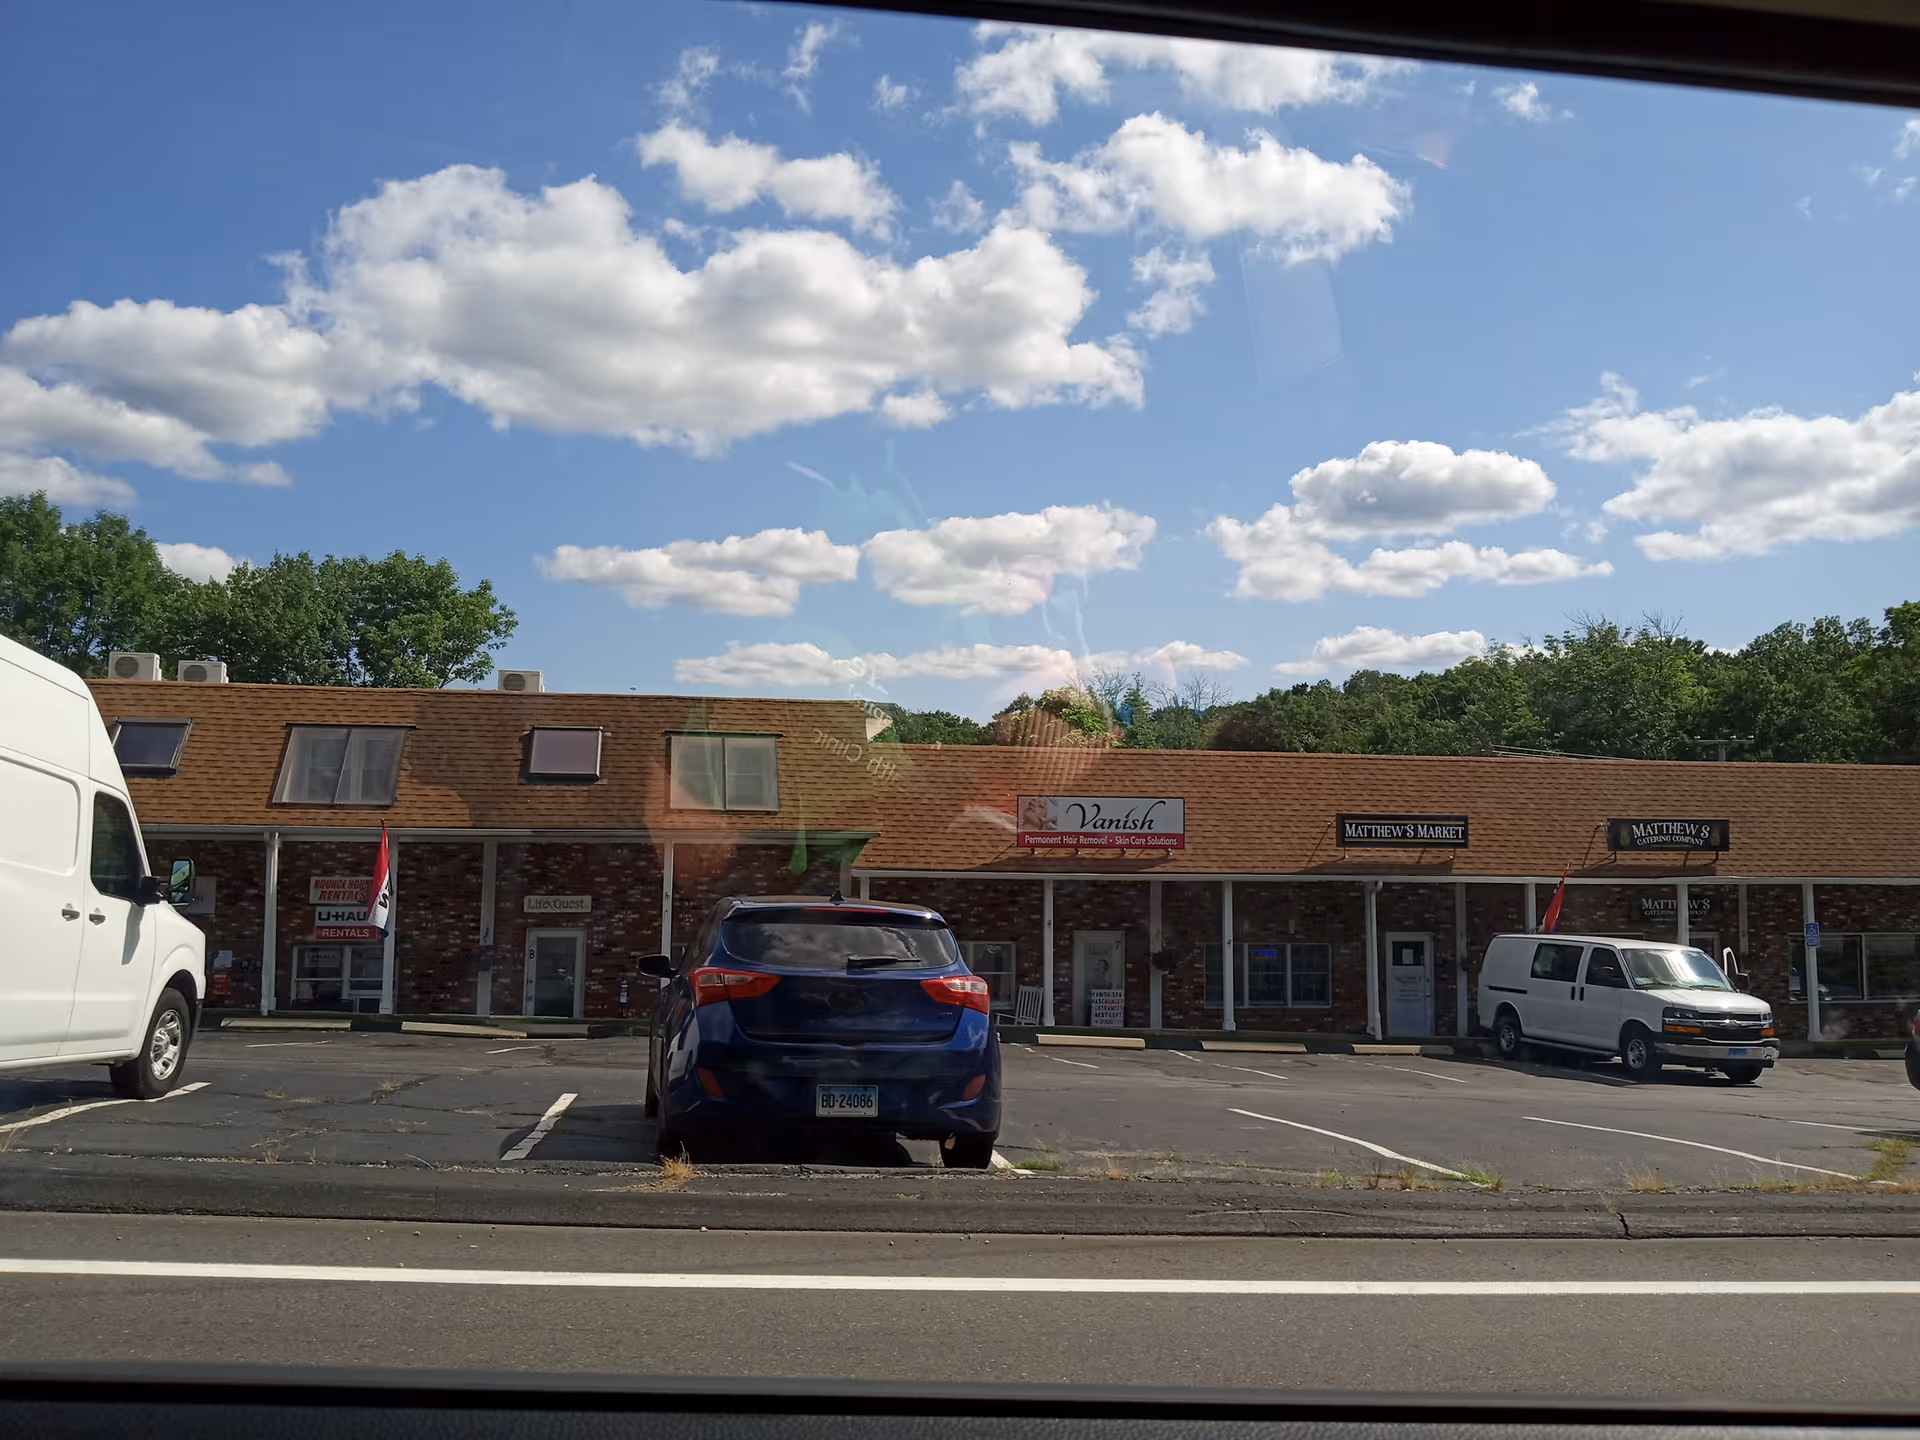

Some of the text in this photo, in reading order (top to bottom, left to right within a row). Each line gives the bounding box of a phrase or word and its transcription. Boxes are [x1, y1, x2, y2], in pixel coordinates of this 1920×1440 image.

[1065, 800, 1166, 830] Vanish
[1345, 823, 1465, 839] MATTHEW'S MARKET
[1025, 835, 1177, 846] Permanent Hair Removal Skin Care Solutions
[1636, 835, 1704, 846] CATERING COMPANY
[314, 879, 370, 889] BOUNCE HOUS
[318, 890, 368, 901] RENTALS
[553, 899, 585, 911] Quest
[1642, 898, 1710, 910] MATTW'S
[317, 911, 368, 921] U-HAU
[322, 928, 370, 938] RENTALS
